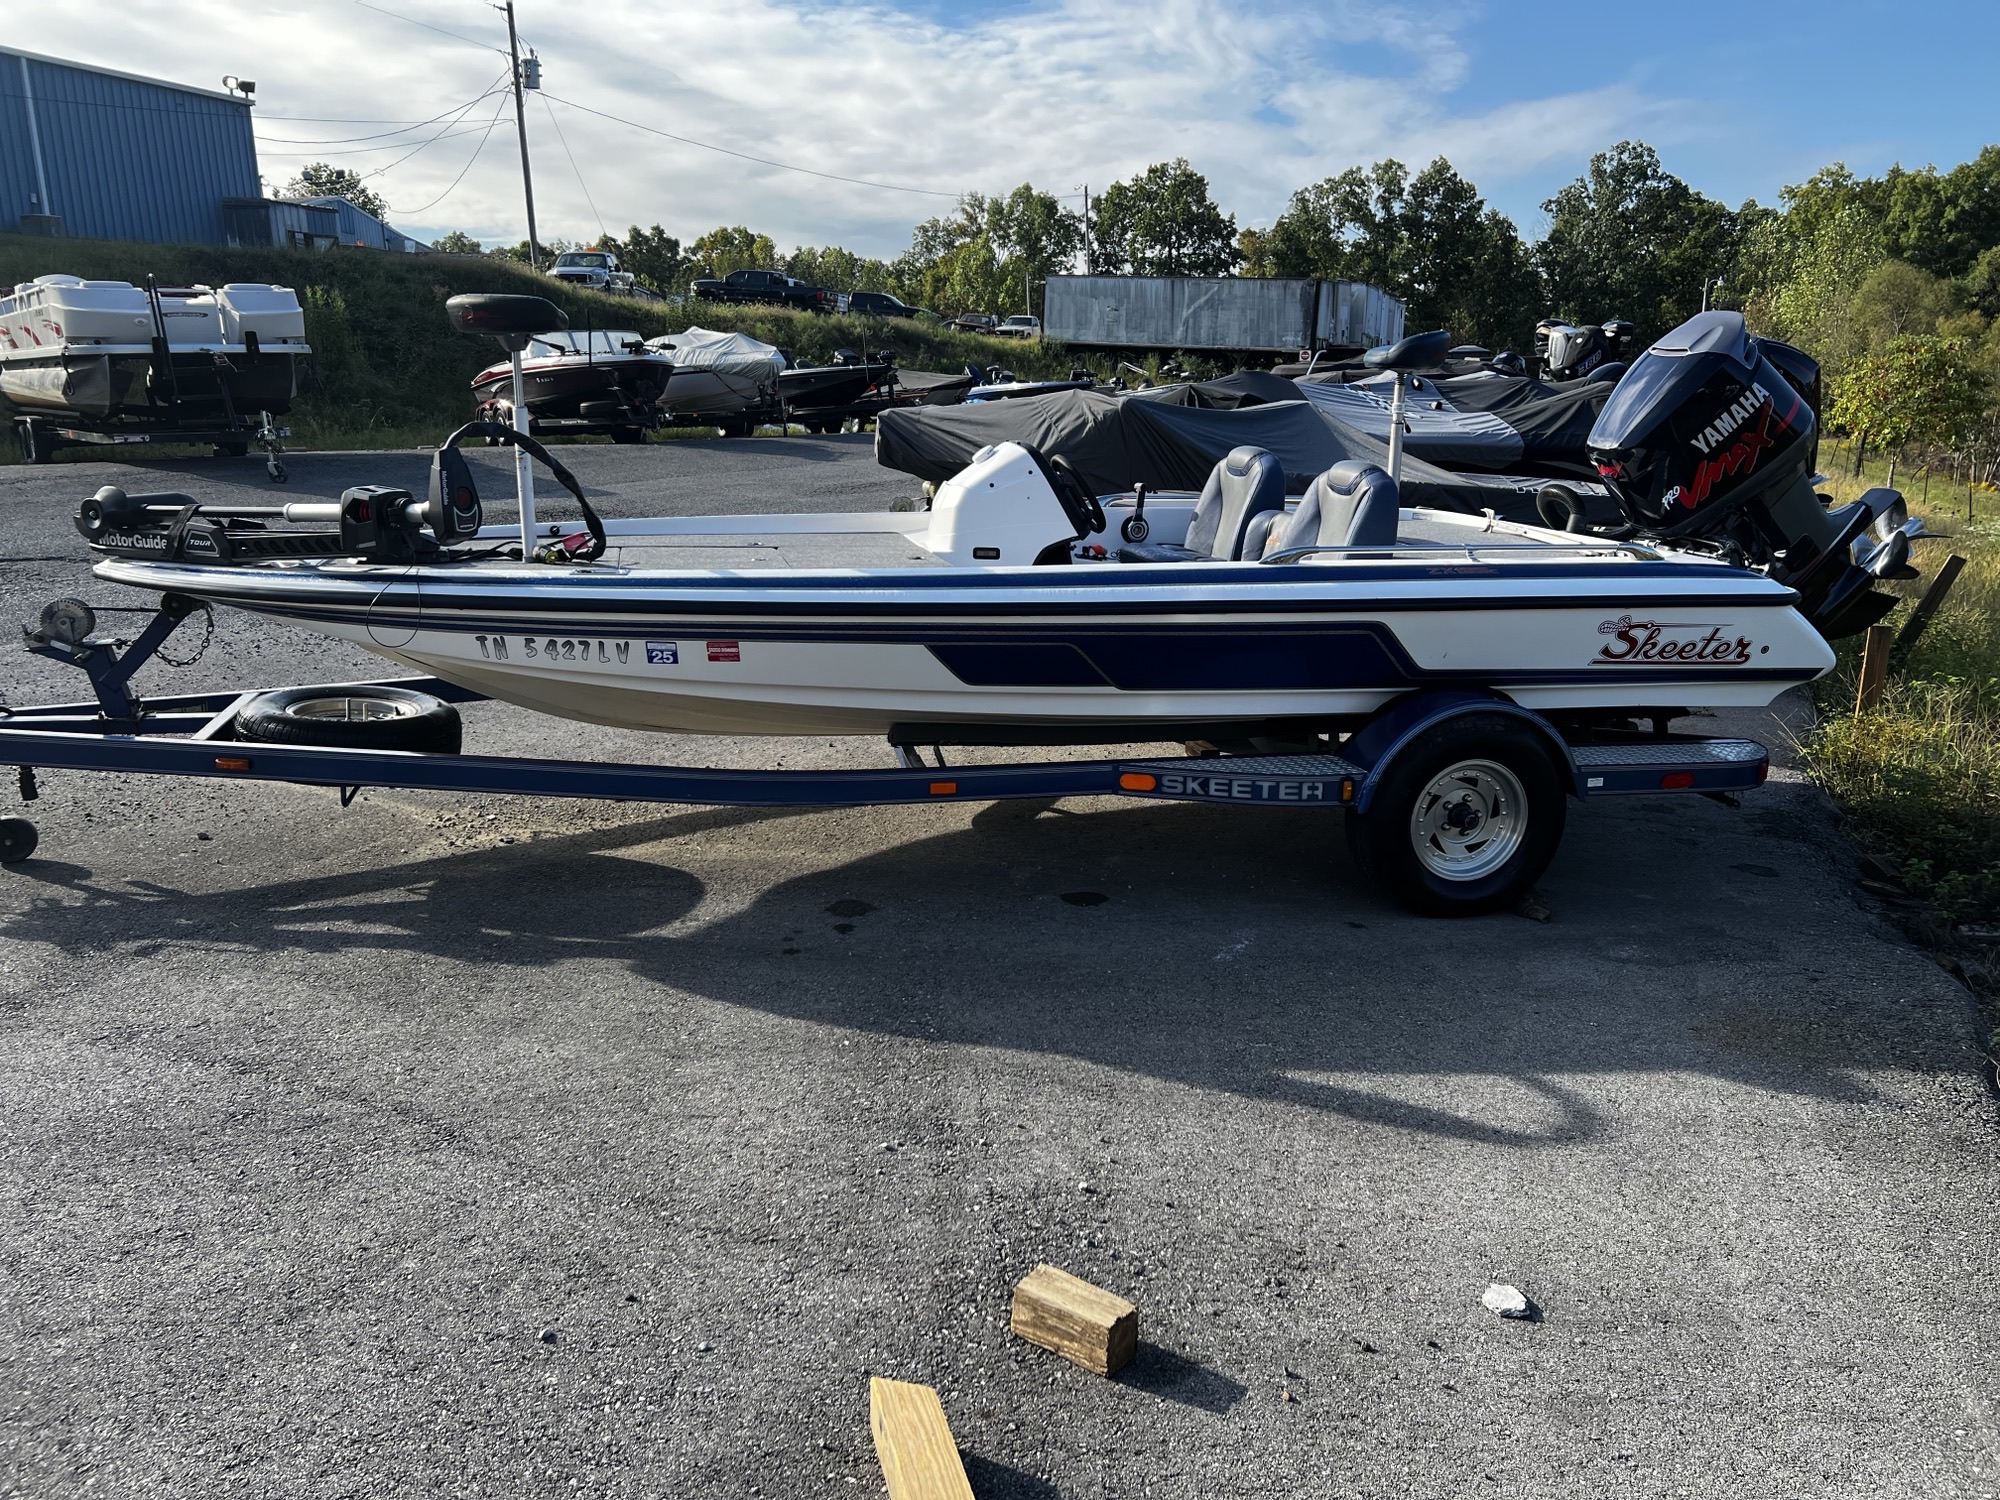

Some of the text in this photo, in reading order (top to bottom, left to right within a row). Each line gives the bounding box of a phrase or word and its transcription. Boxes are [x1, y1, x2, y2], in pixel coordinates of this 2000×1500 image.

[1690, 381, 1770, 454] YAMAHA
[441, 470, 450, 506] MotorGuide
[1661, 485, 1680, 511] PRO
[99, 531, 168, 550] MotorGuide
[189, 539, 212, 547] TOUR
[475, 635, 509, 660] TN
[1598, 621, 1753, 661] Skeeter
[652, 650, 674, 663] 25
[1161, 775, 1324, 800] SKEETER
